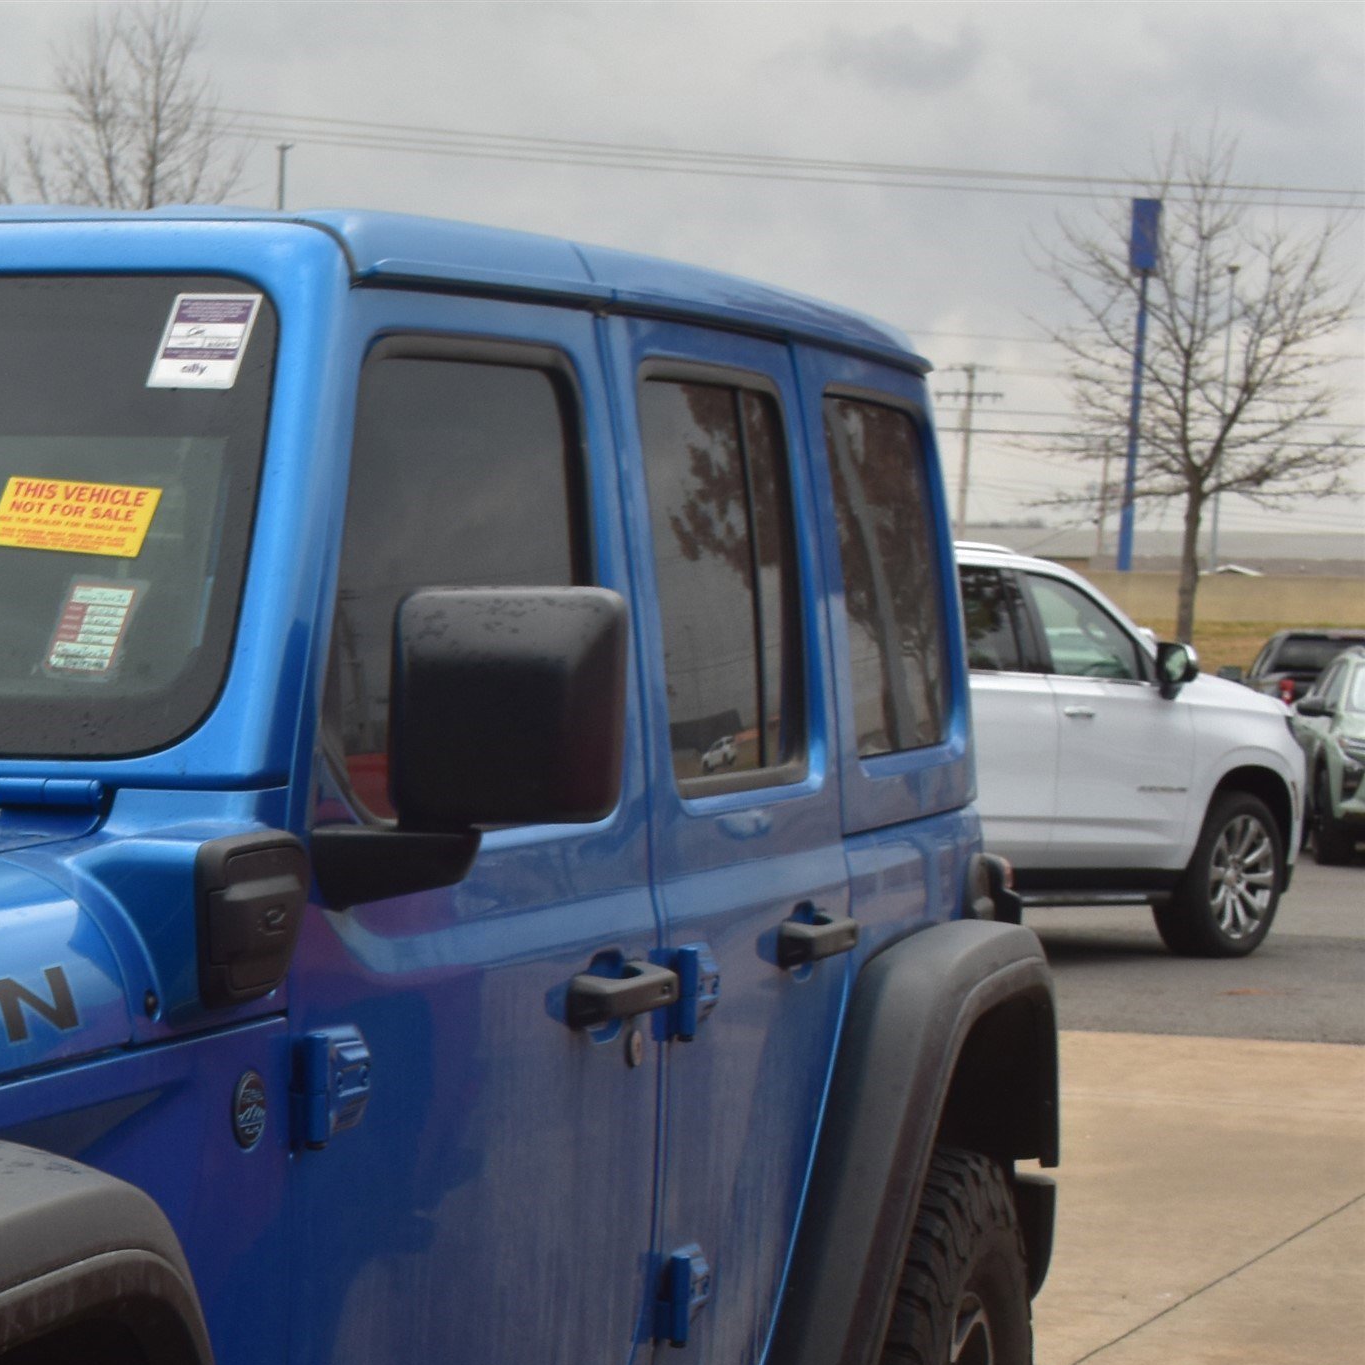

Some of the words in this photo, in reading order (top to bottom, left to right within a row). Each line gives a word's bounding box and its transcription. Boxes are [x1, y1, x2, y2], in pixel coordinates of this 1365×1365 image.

[13, 481, 59, 500] THIS
[64, 486, 148, 507] VEHICLE
[10, 501, 44, 513] NOT
[49, 504, 85, 518] FOR
[90, 507, 136, 522] SALE
